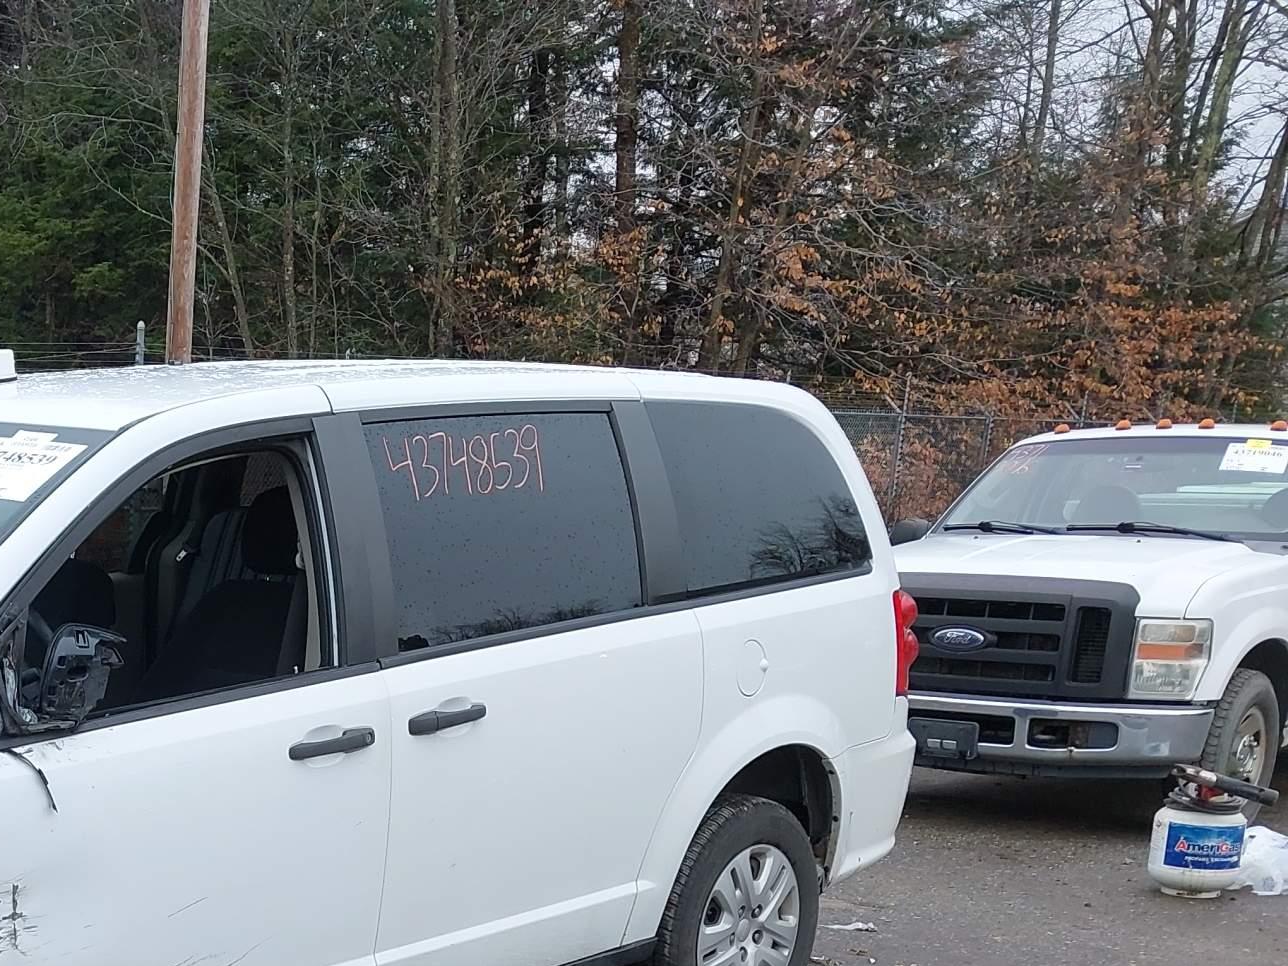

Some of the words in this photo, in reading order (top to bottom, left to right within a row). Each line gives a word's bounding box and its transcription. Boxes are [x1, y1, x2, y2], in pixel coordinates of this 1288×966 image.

[382, 424, 544, 501] 43748539
[944, 631, 972, 644] Ford
[1175, 840, 1241, 854] AmeriGas
